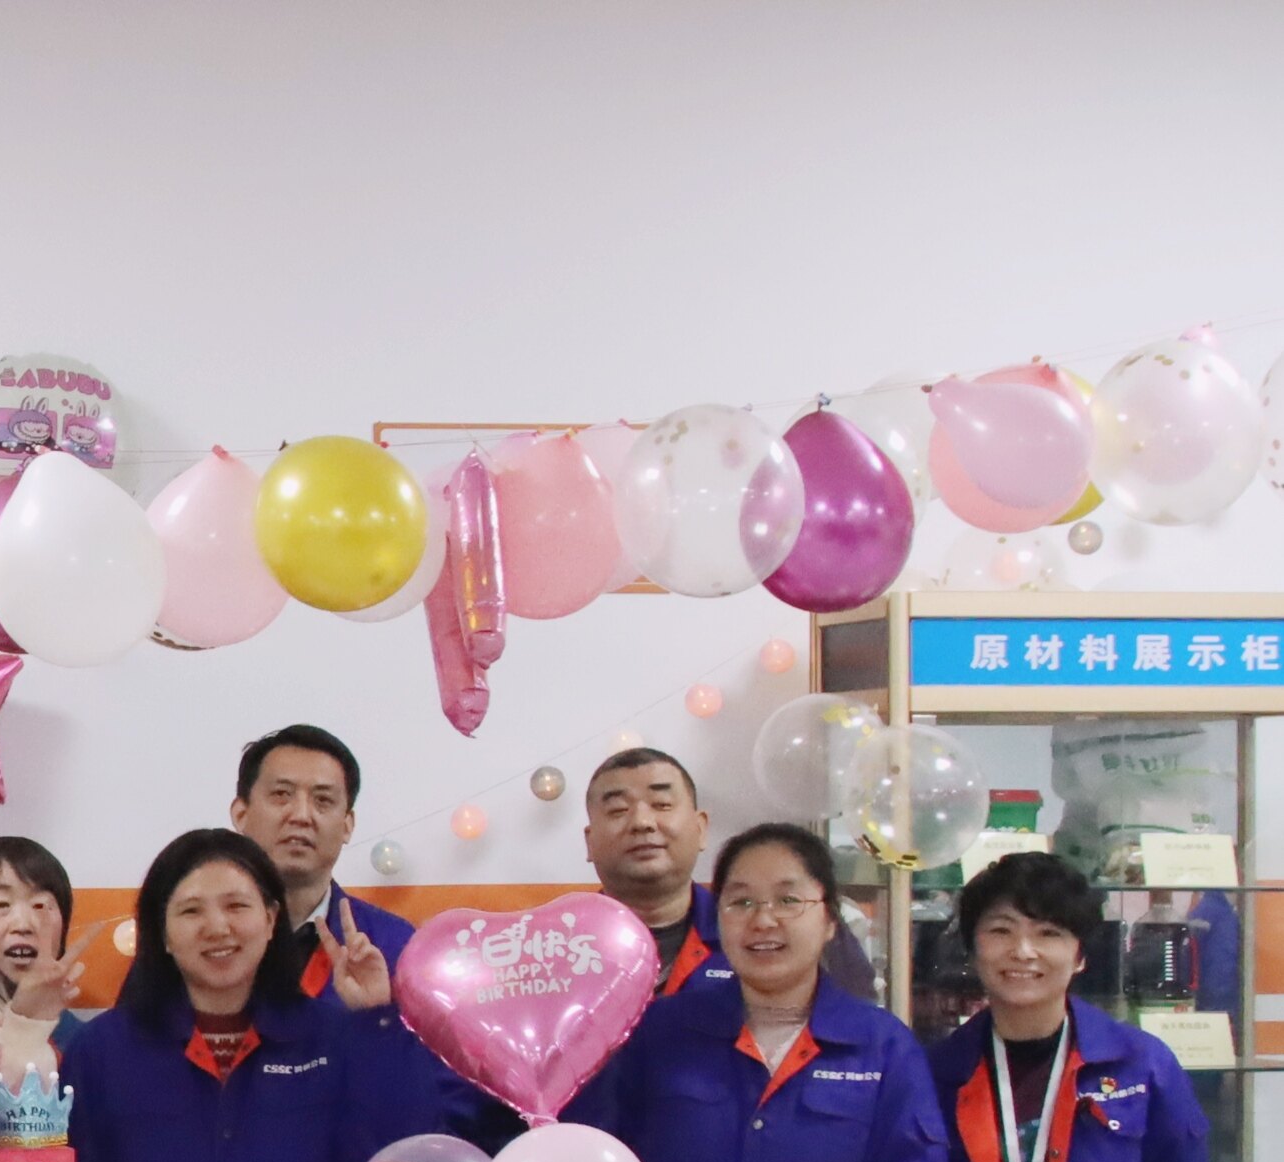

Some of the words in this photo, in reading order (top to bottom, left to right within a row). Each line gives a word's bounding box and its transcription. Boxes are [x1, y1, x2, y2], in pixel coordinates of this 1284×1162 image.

[970, 633, 1281, 672] 原材料展示柜
[493, 961, 555, 983] HAPPY
[476, 977, 573, 1004] BIRTHDAY
[6, 1106, 51, 1121] HAPPY
[0, 1121, 55, 1132] BIRTHDAY
